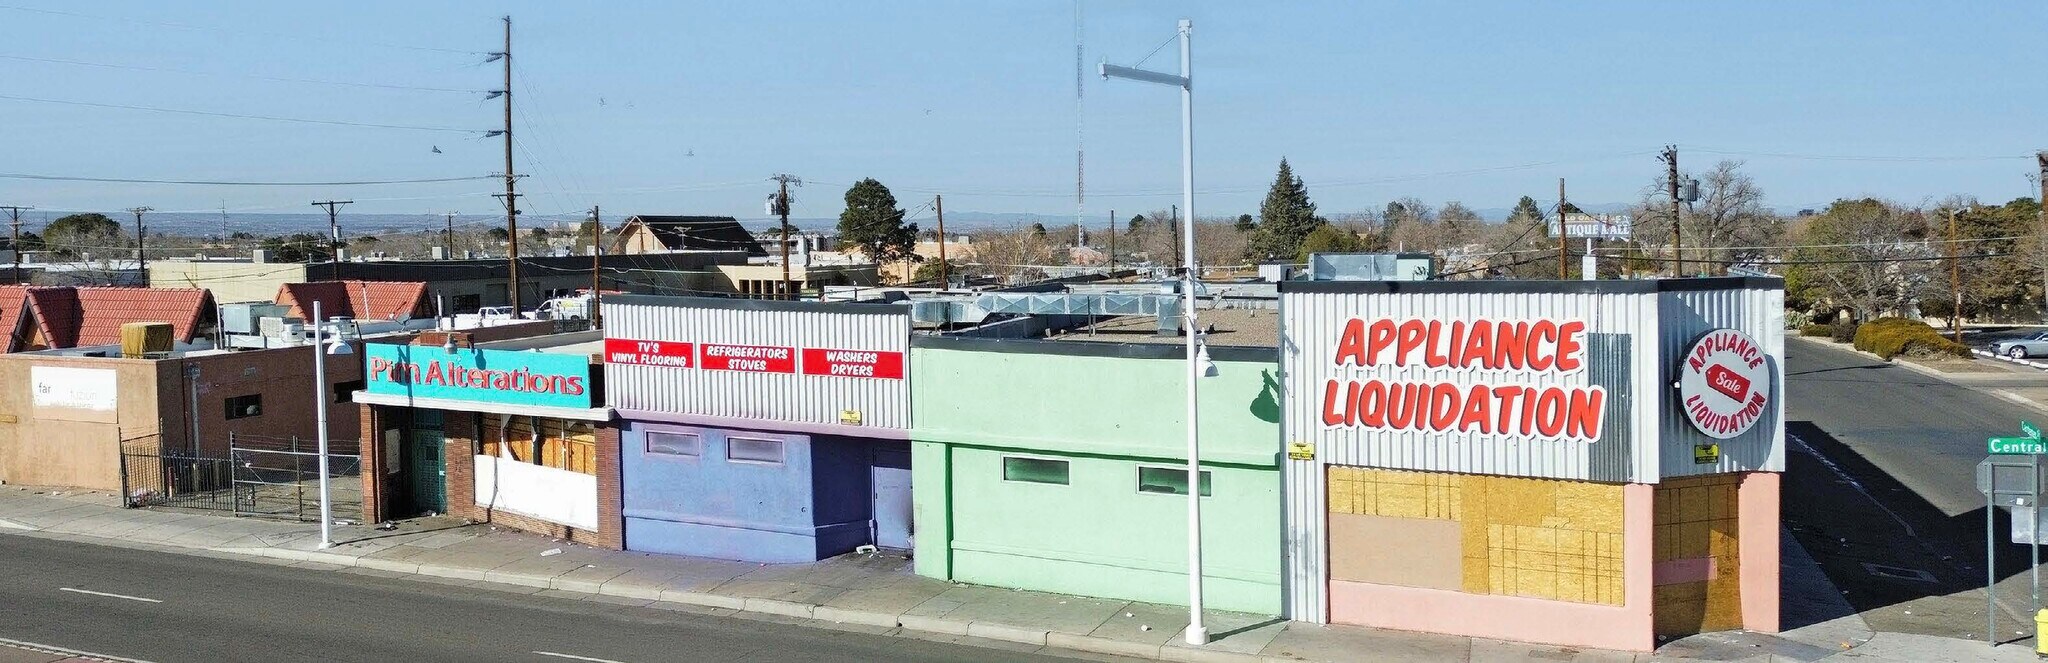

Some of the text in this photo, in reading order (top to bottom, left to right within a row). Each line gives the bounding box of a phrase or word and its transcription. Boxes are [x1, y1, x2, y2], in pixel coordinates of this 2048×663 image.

[637, 342, 660, 353] TV'S
[707, 345, 789, 360] REFRIGERATORS
[1335, 318, 1585, 372] APPLIANCE
[611, 352, 687, 367] VINYL FLOORING
[826, 351, 878, 364] WASHERS
[1689, 333, 1763, 374] APPLIANCE
[728, 359, 767, 371] STOVES
[831, 364, 874, 377] DRYERS
[424, 359, 585, 396] Alterations
[1715, 371, 1741, 394] Sale
[1322, 379, 1604, 439] LIQUIDATION
[1686, 391, 1766, 434] LIQUIDATION
[1990, 439, 2047, 453] Central
